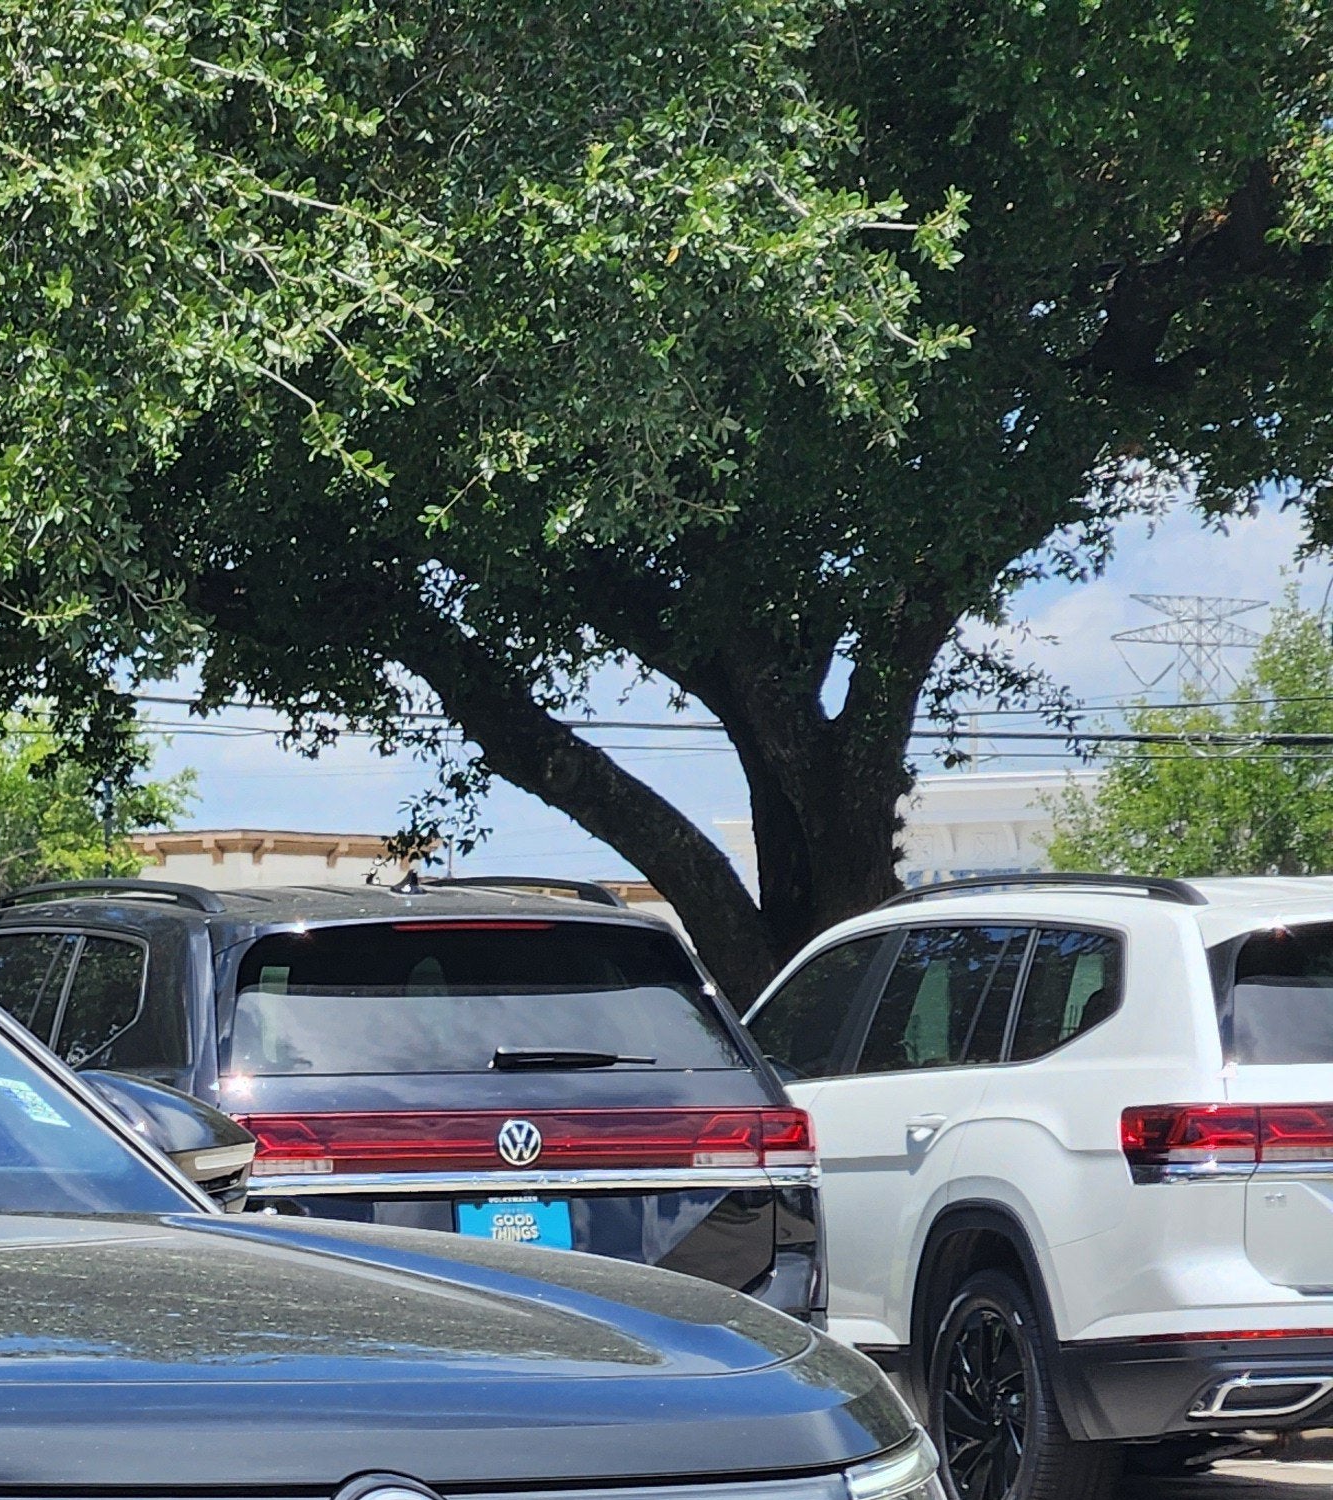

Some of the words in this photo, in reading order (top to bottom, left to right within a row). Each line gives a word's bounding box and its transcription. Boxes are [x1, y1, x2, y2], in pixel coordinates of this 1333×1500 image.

[501, 1122, 539, 1163] VW
[494, 1214, 535, 1226] GOOD
[491, 1225, 540, 1241] THINGS
